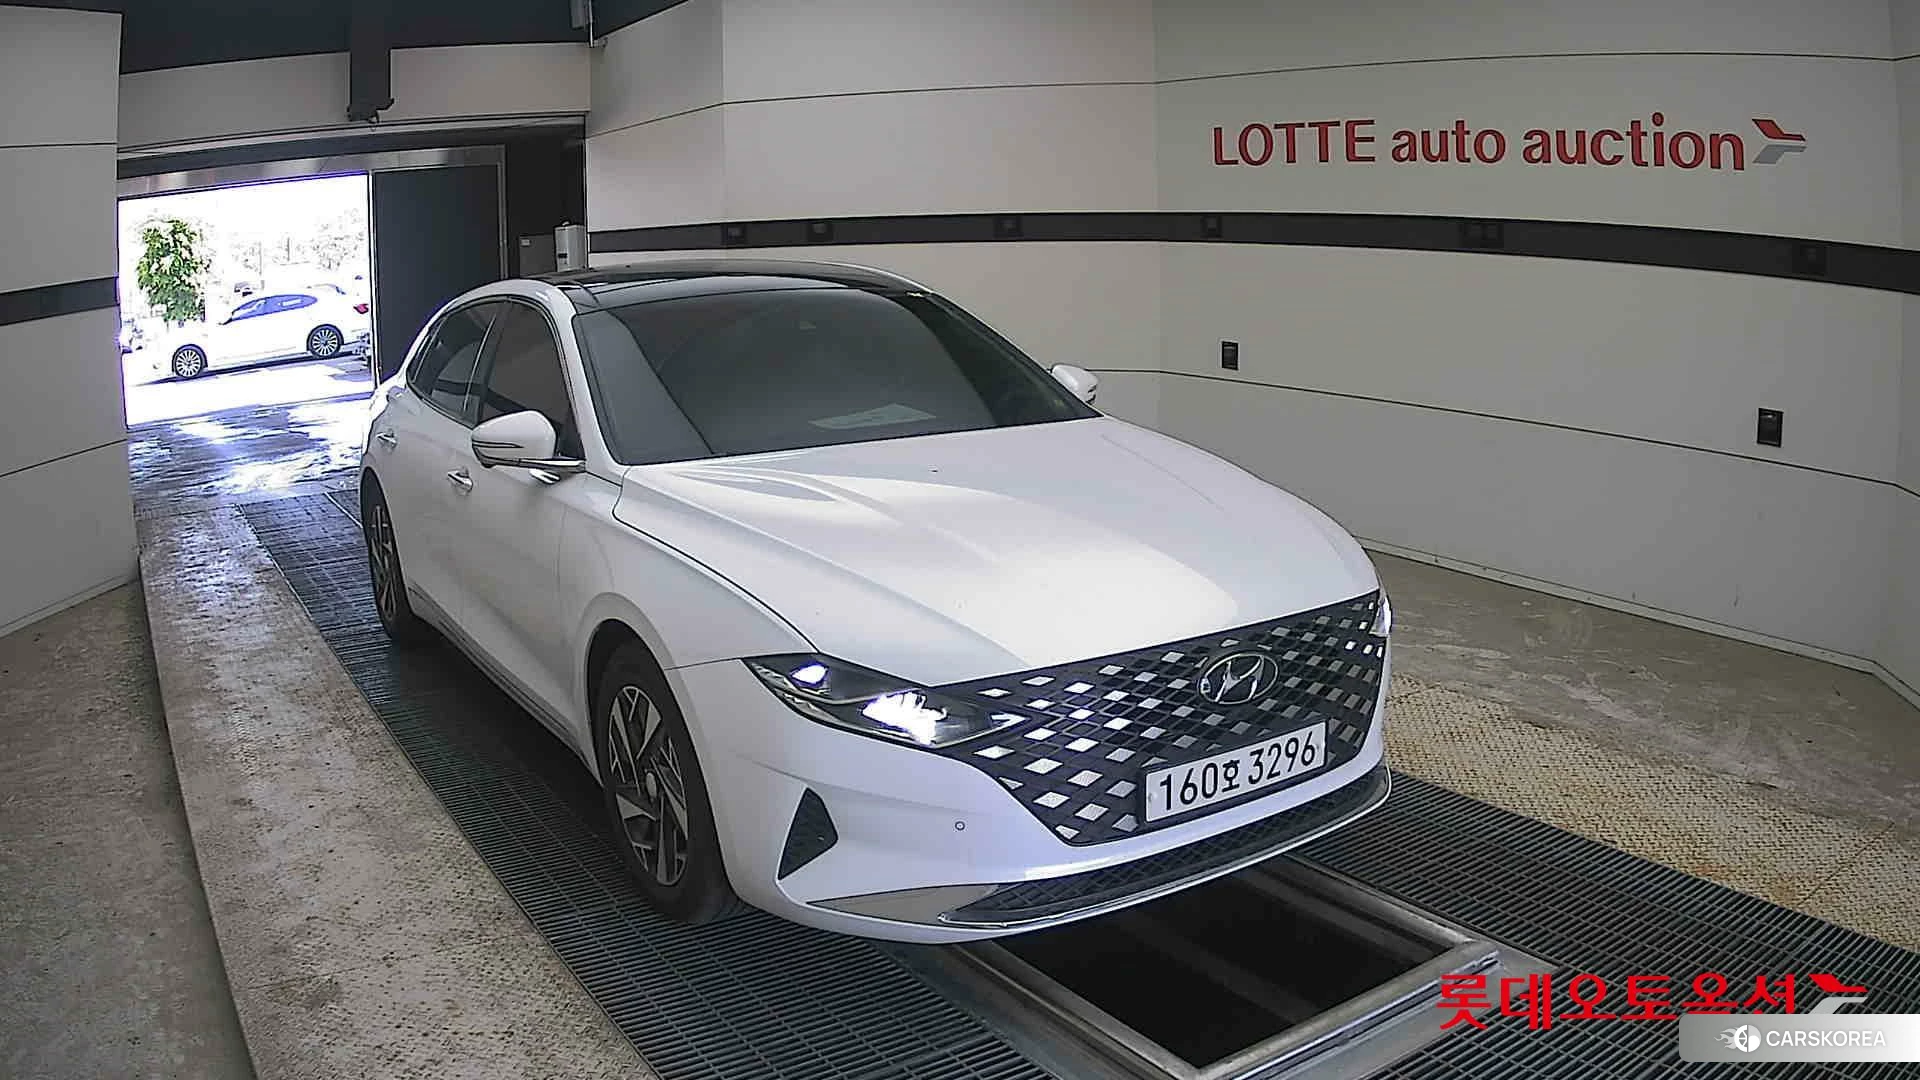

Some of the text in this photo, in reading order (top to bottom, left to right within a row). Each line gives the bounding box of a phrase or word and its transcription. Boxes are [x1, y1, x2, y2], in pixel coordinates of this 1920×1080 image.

[1212, 112, 1745, 171] LOTTE auto auction
[1159, 731, 1316, 811] 160호 3296
